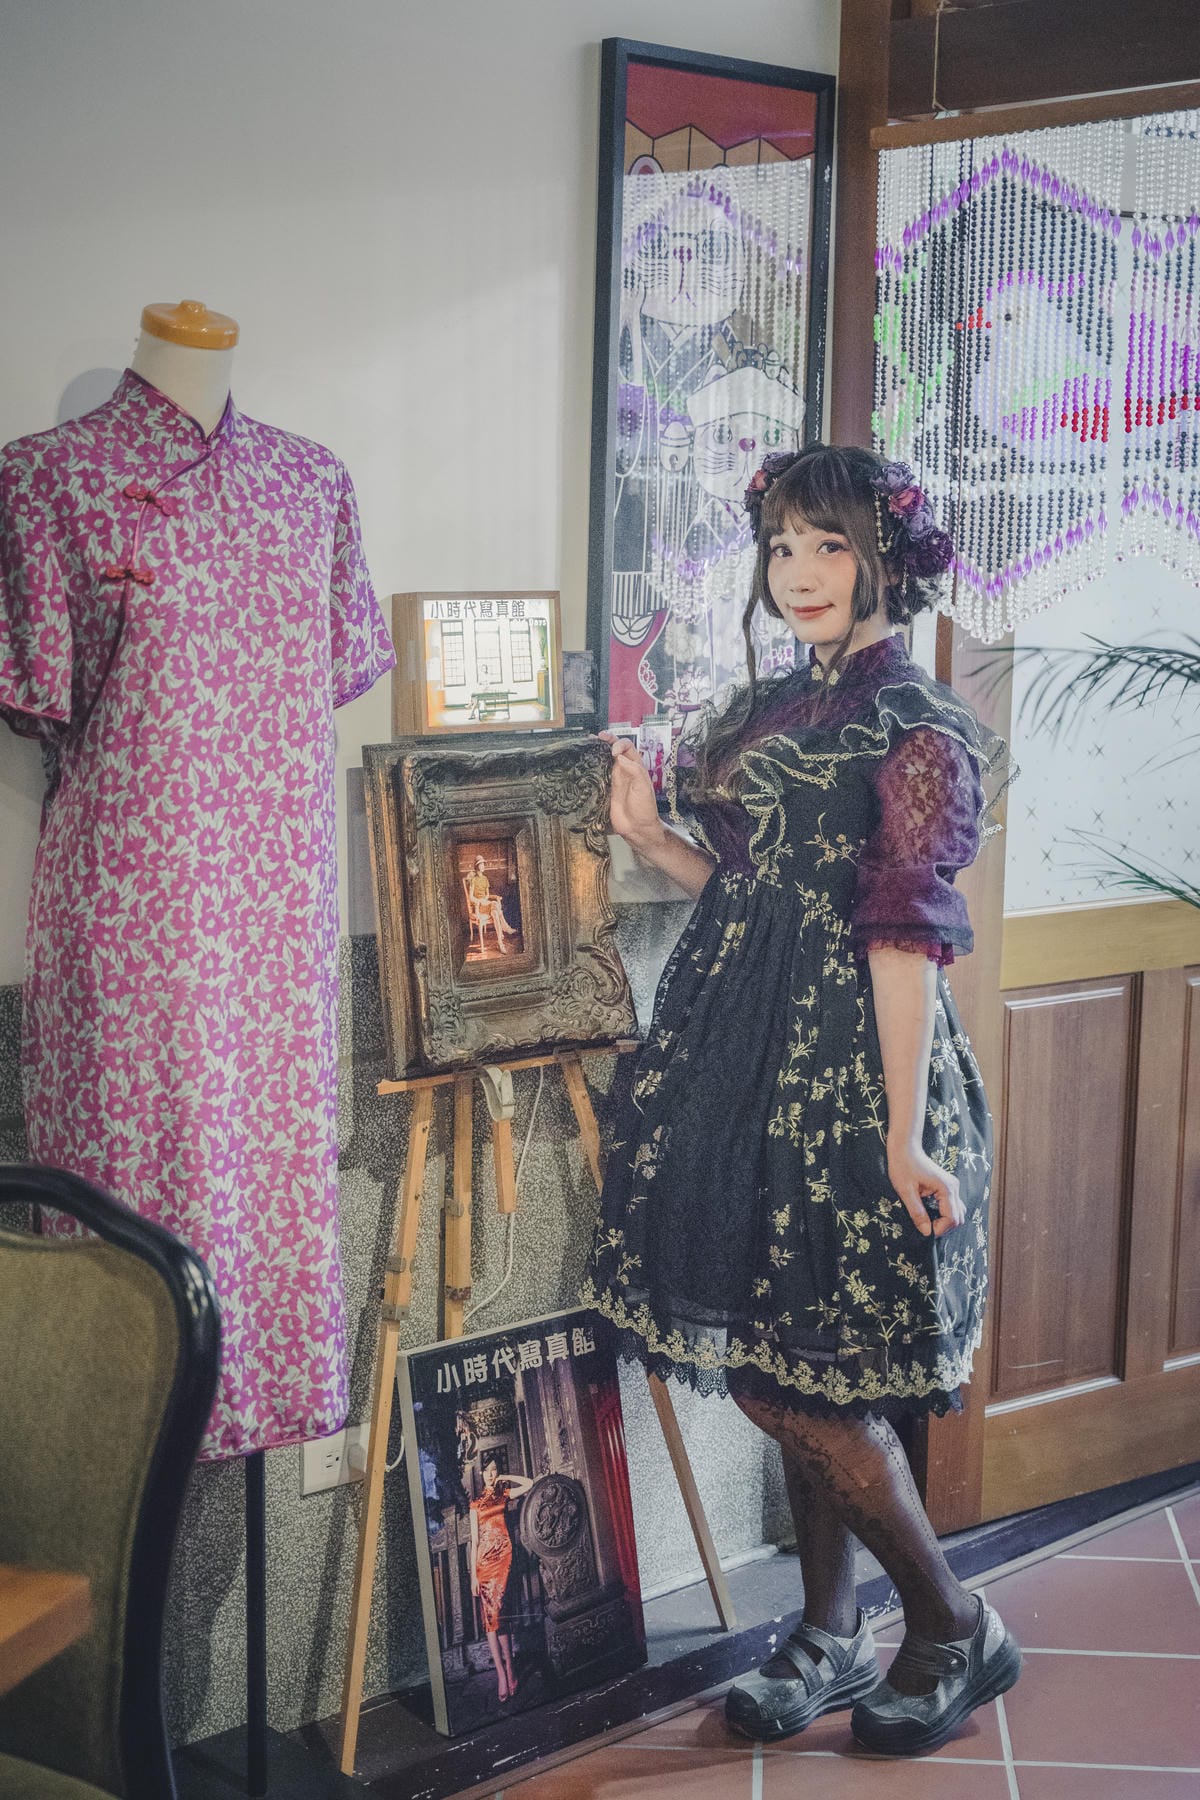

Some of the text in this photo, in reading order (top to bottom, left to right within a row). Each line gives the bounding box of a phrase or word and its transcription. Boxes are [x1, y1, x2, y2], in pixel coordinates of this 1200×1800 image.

[431, 600, 525, 617] 小時代寫真館
[437, 1327, 596, 1393] 小時代寫真館
